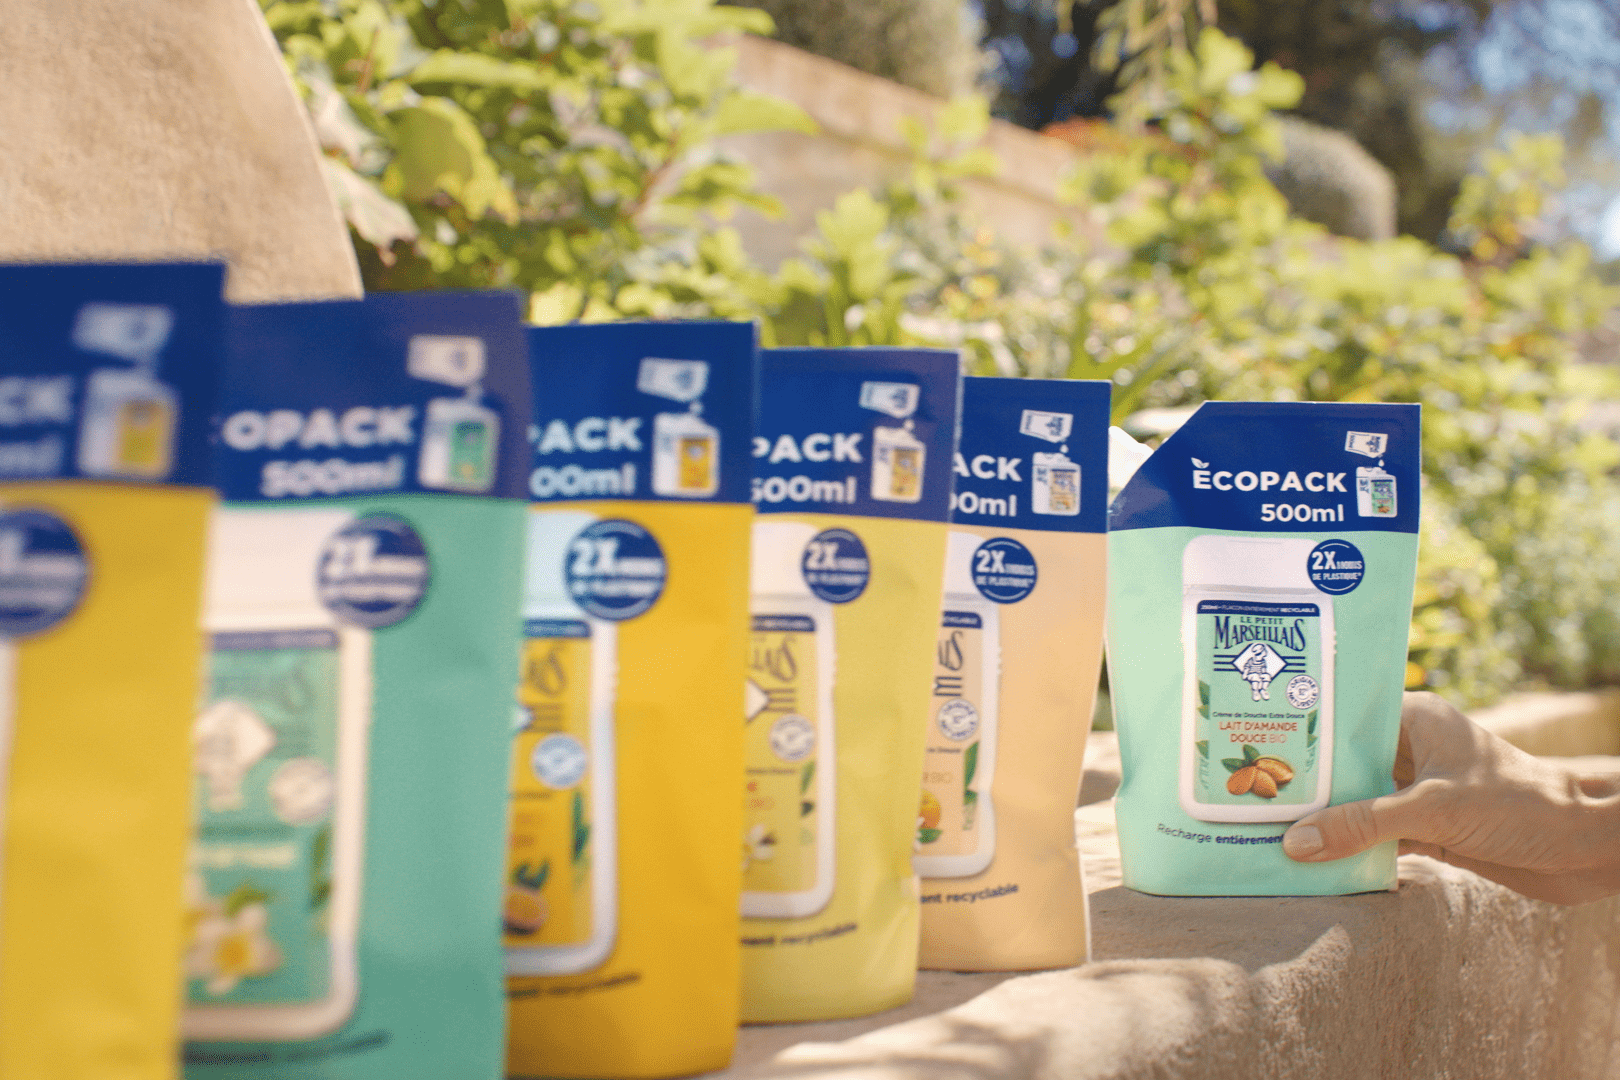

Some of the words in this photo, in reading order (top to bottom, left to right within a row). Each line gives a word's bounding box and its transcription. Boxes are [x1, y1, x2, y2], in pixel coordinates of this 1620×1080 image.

[1260, 503, 1344, 522] 500ml
[976, 549, 1005, 573] 2X
[1311, 551, 1336, 570] 2X
[1219, 721, 1242, 730] LAIT
[1244, 721, 1297, 731] D'AMANDE
[1230, 733, 1266, 743] DOUCE
[1269, 734, 1287, 743] BIO
[1157, 823, 1212, 843] Recharge
